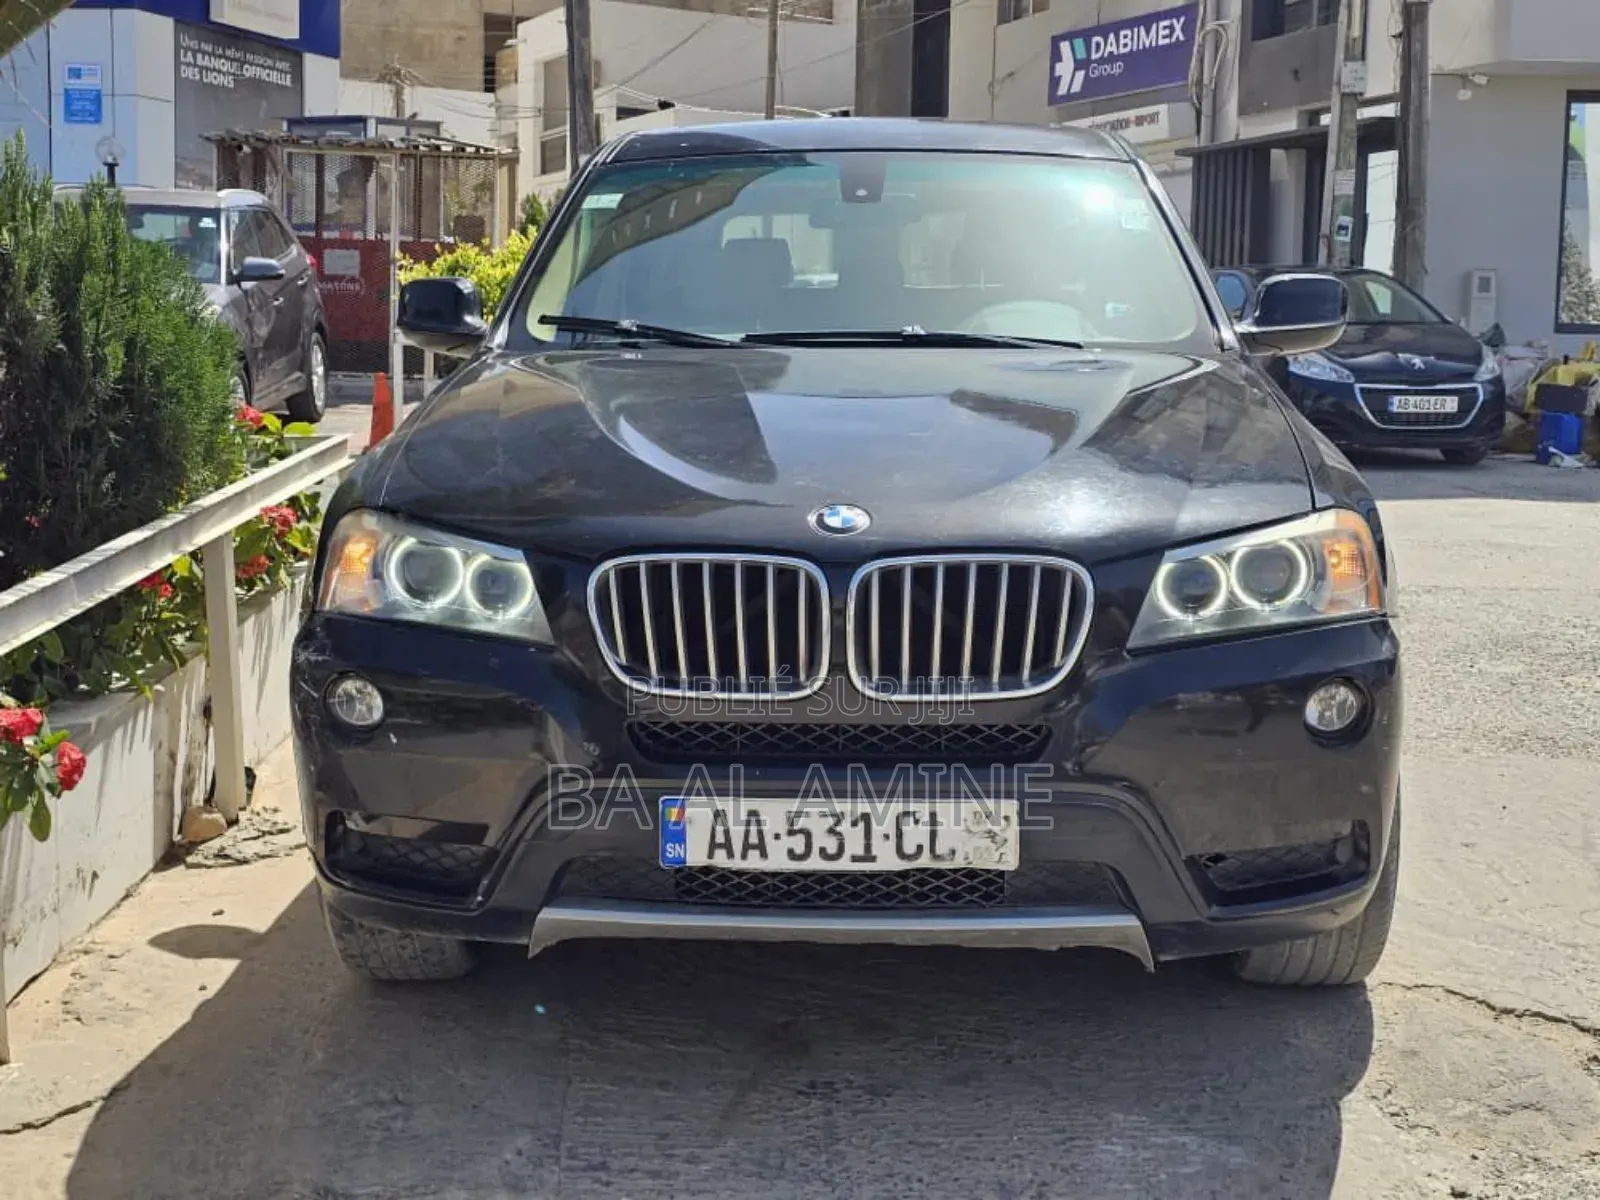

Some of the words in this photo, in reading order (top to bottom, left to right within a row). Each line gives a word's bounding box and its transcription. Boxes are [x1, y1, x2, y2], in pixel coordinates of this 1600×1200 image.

[1090, 15, 1186, 60] DABIMEX
[180, 48, 194, 64] LA
[196, 52, 241, 75] BANQUE
[242, 63, 293, 87] OFFICIELLE
[180, 64, 200, 80] DES
[202, 69, 235, 88] LIONS
[1089, 62, 1124, 78] Group
[665, 843, 686, 858] SN
